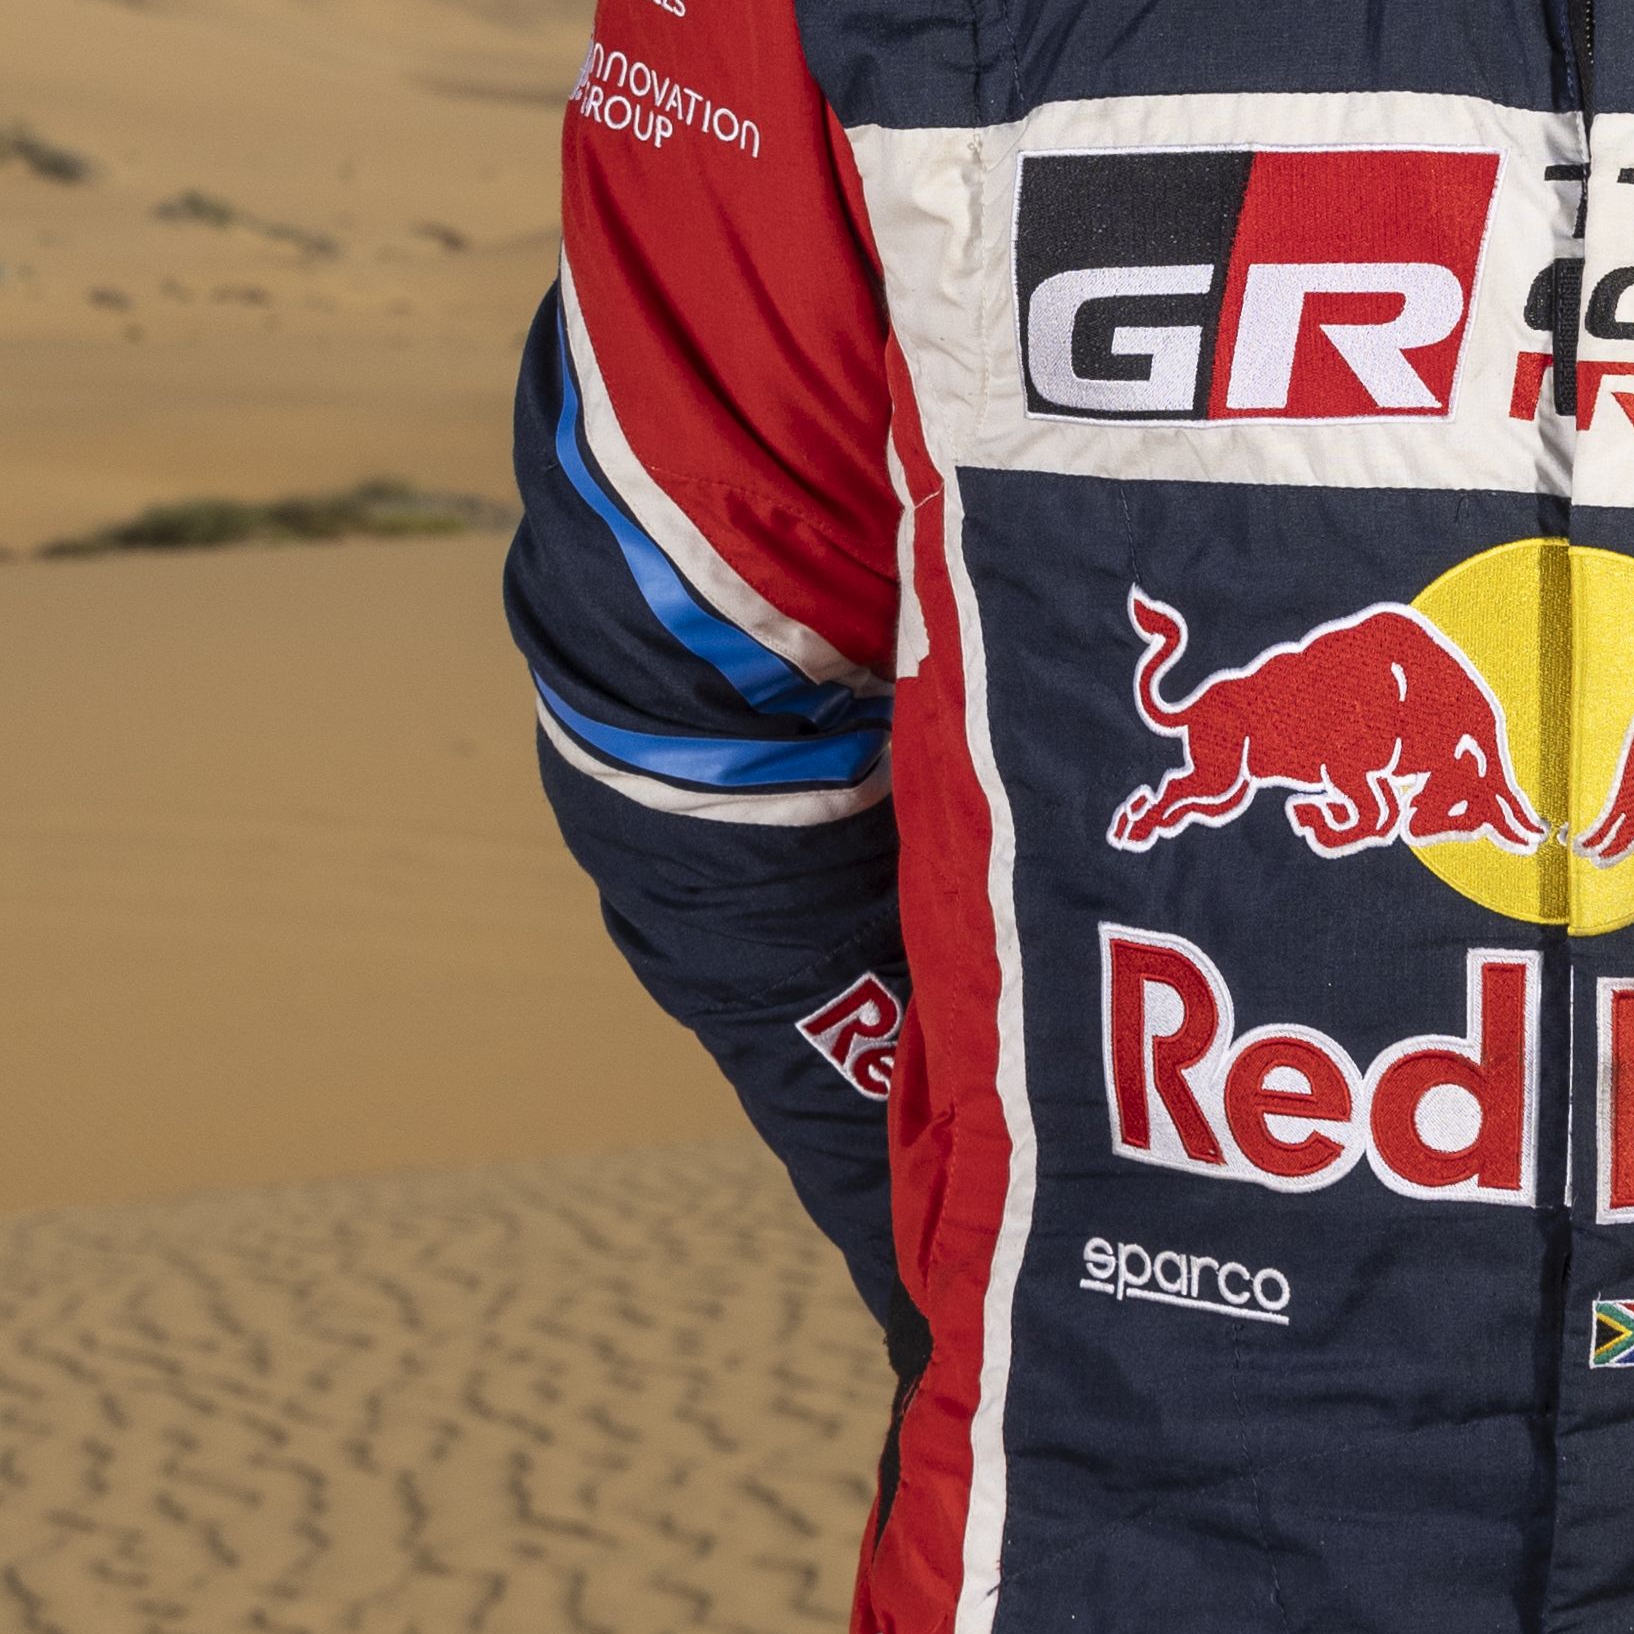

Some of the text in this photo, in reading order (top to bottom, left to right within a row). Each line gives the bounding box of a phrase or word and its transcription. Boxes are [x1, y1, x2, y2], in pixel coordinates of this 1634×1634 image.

[1027, 262, 1464, 412] GR
[795, 970, 901, 1102] Re
[1098, 921, 1544, 1208] Red
[1083, 1237, 1290, 1312] sparco
